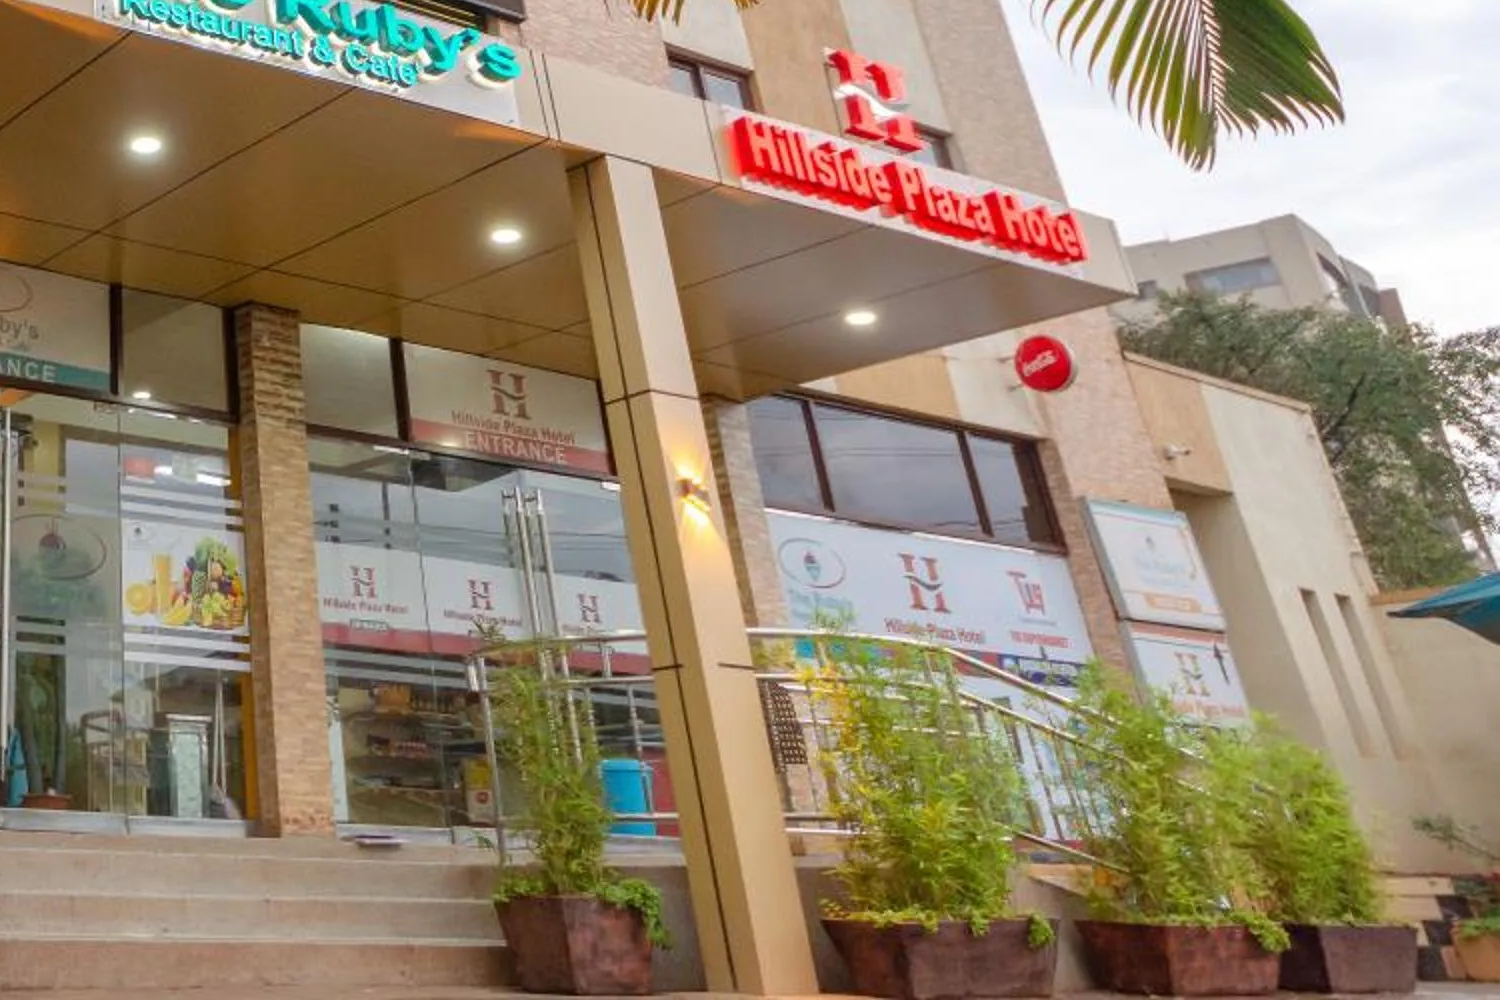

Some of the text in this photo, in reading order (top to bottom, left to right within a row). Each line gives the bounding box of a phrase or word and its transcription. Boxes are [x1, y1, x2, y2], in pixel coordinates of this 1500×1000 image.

[306, 33, 334, 68] &
[732, 116, 1088, 265] Hillside Plaza Hotel
[465, 431, 566, 464] ENTRANCE
